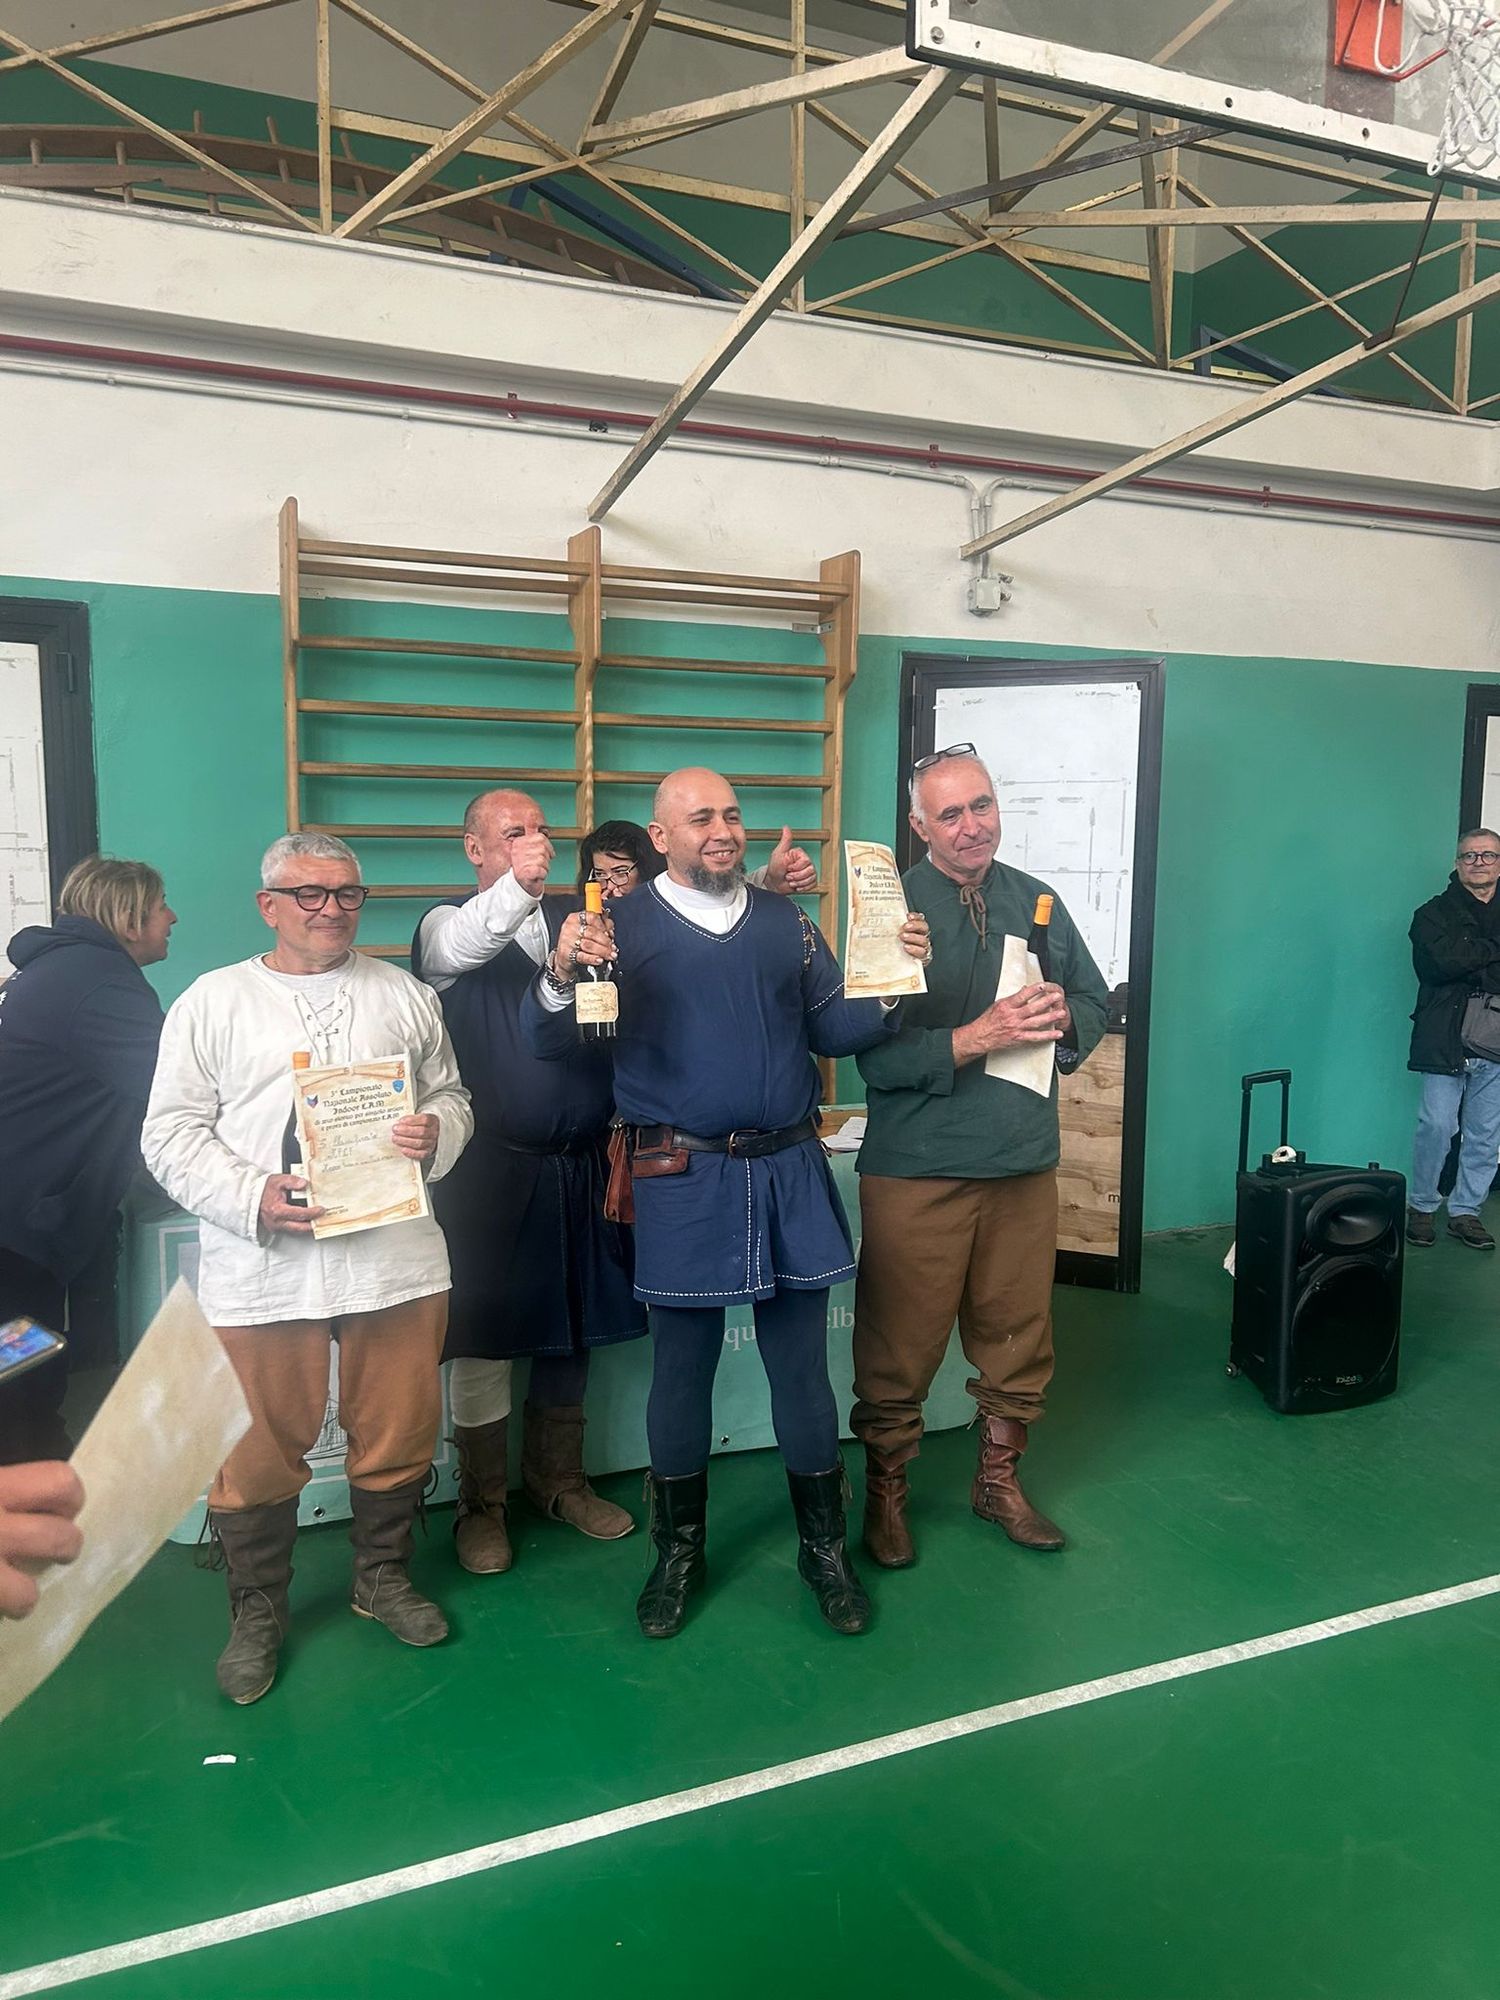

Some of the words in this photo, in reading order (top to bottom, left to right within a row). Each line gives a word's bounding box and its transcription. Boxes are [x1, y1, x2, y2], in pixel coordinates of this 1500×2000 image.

[340, 1083, 383, 1096] Campionato
[359, 1090, 392, 1102] Assoluto
[333, 1104, 360, 1115] Indoor
